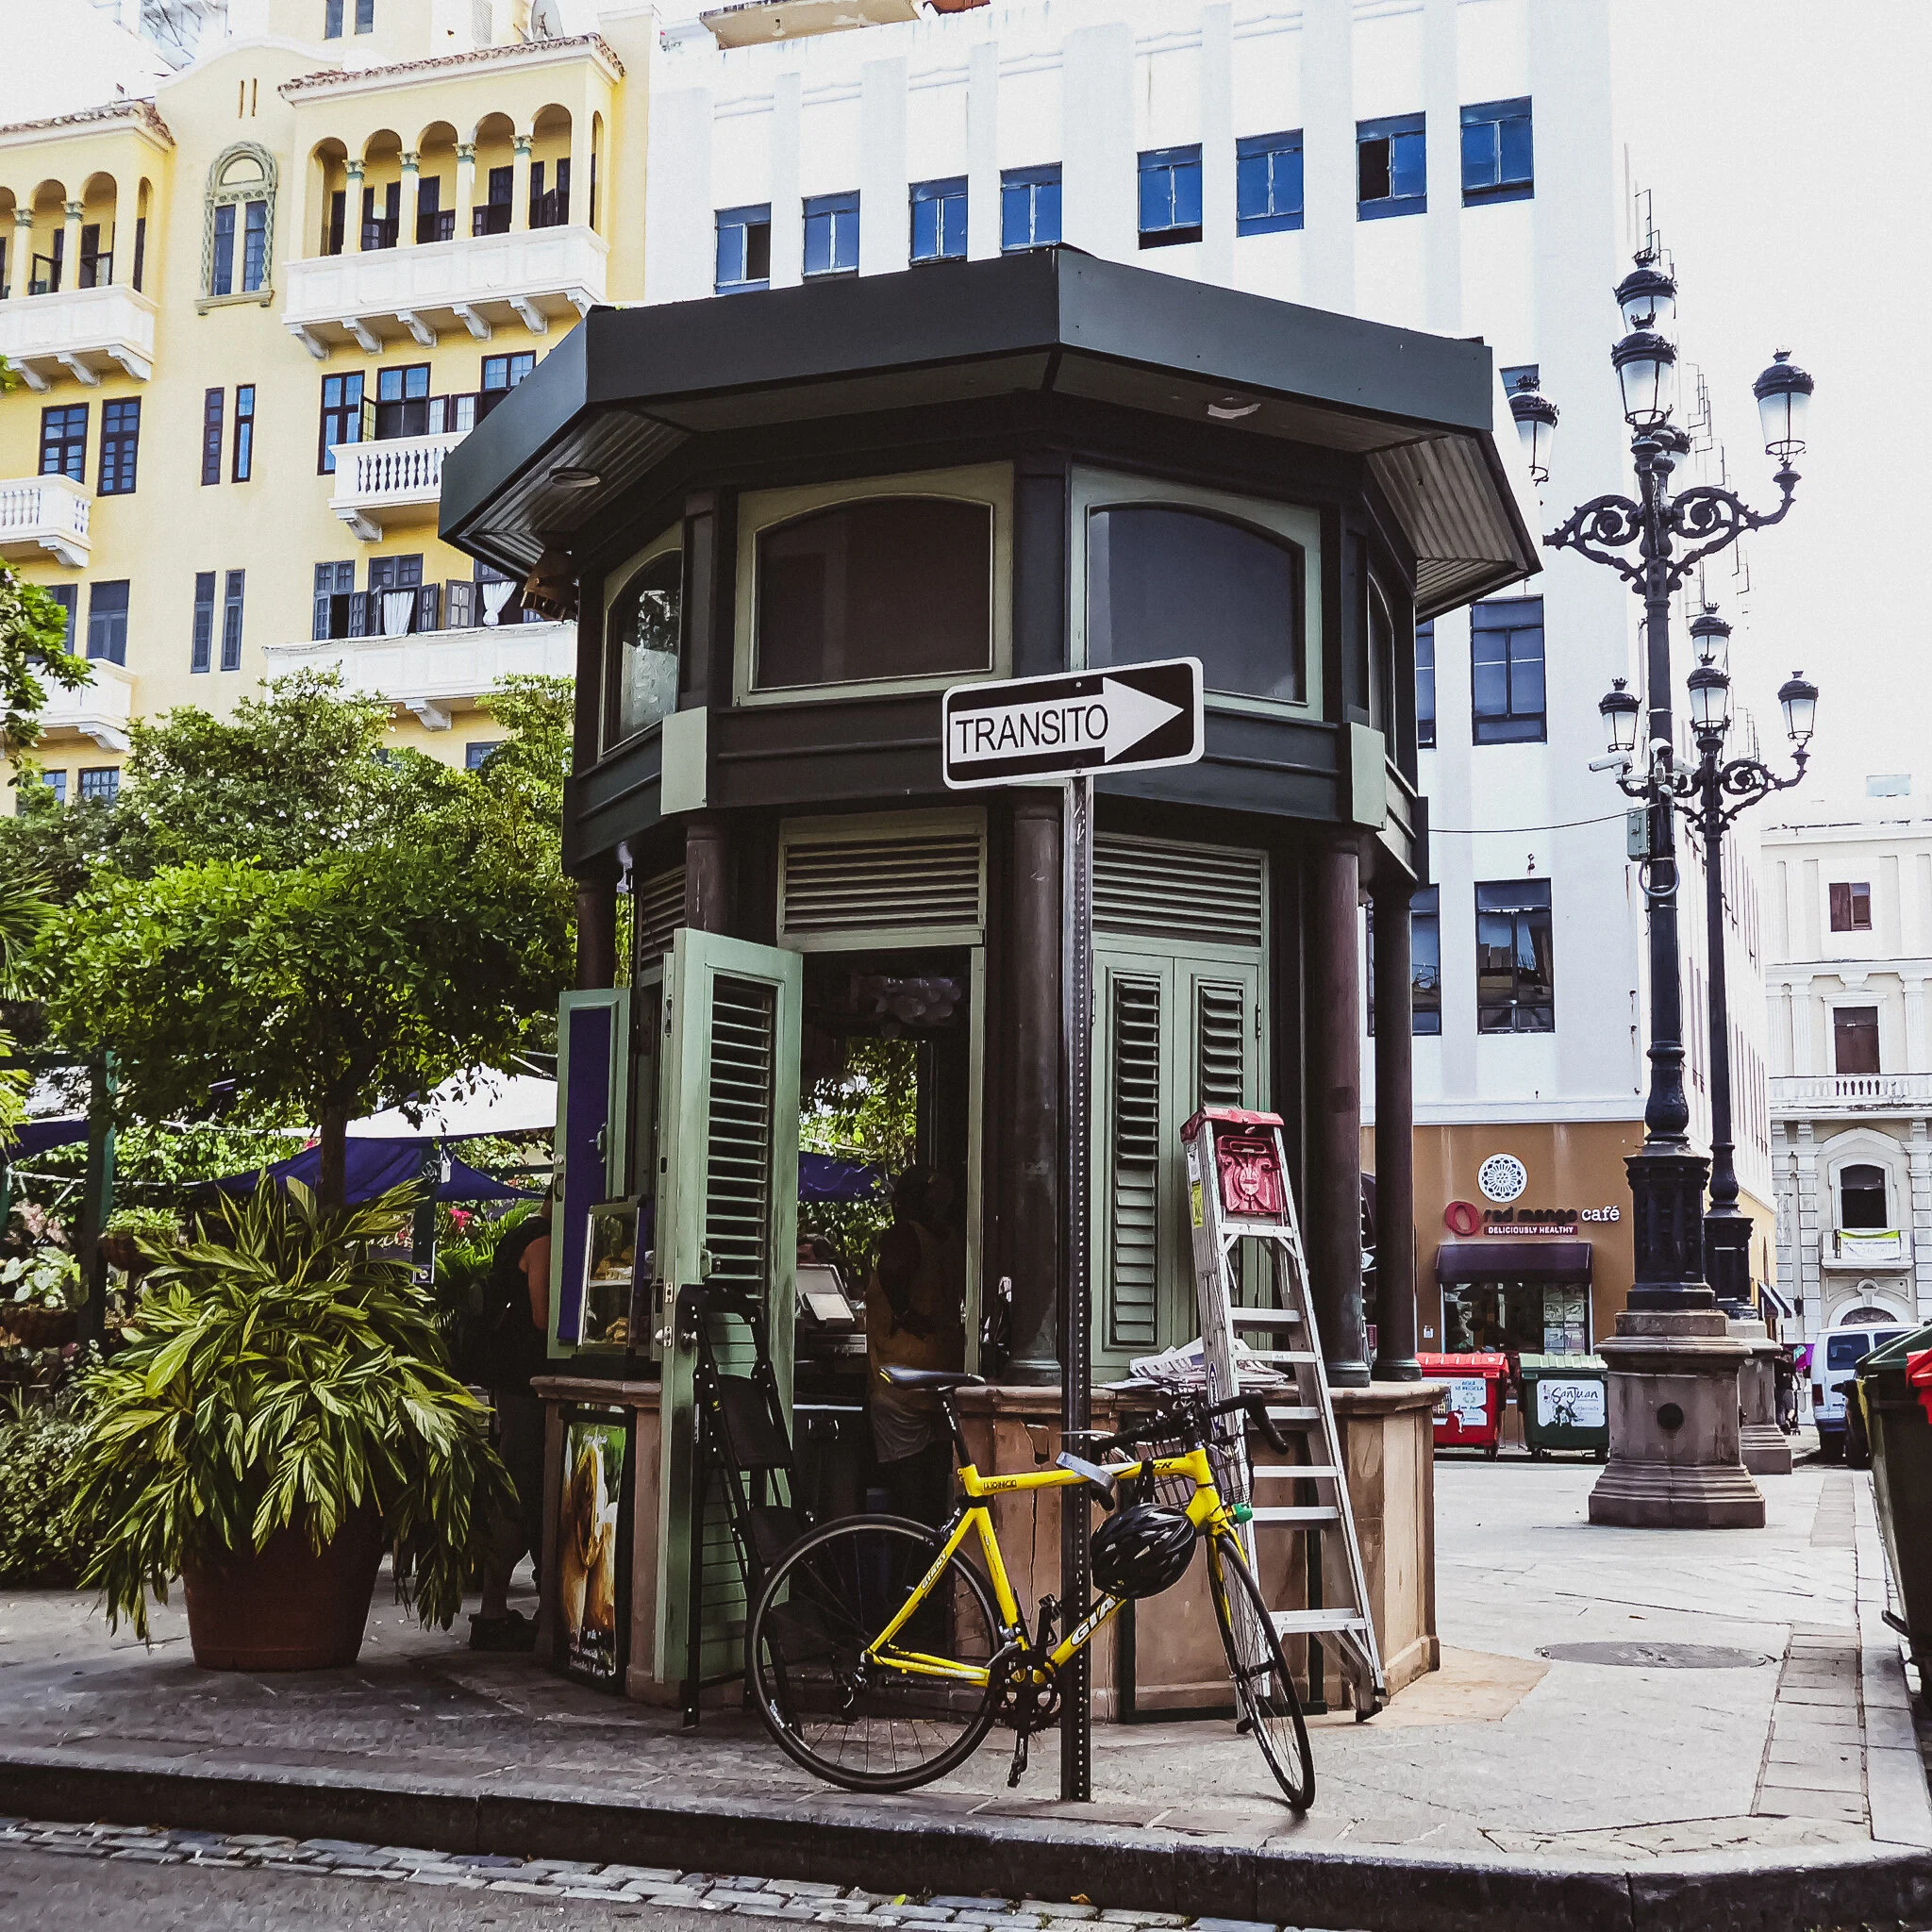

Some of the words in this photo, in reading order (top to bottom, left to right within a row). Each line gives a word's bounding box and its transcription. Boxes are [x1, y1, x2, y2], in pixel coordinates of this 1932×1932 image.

[956, 704, 1108, 754] TRANSITO
[1581, 1205, 1621, 1222] café
[1071, 1595, 1117, 1646] GIA
